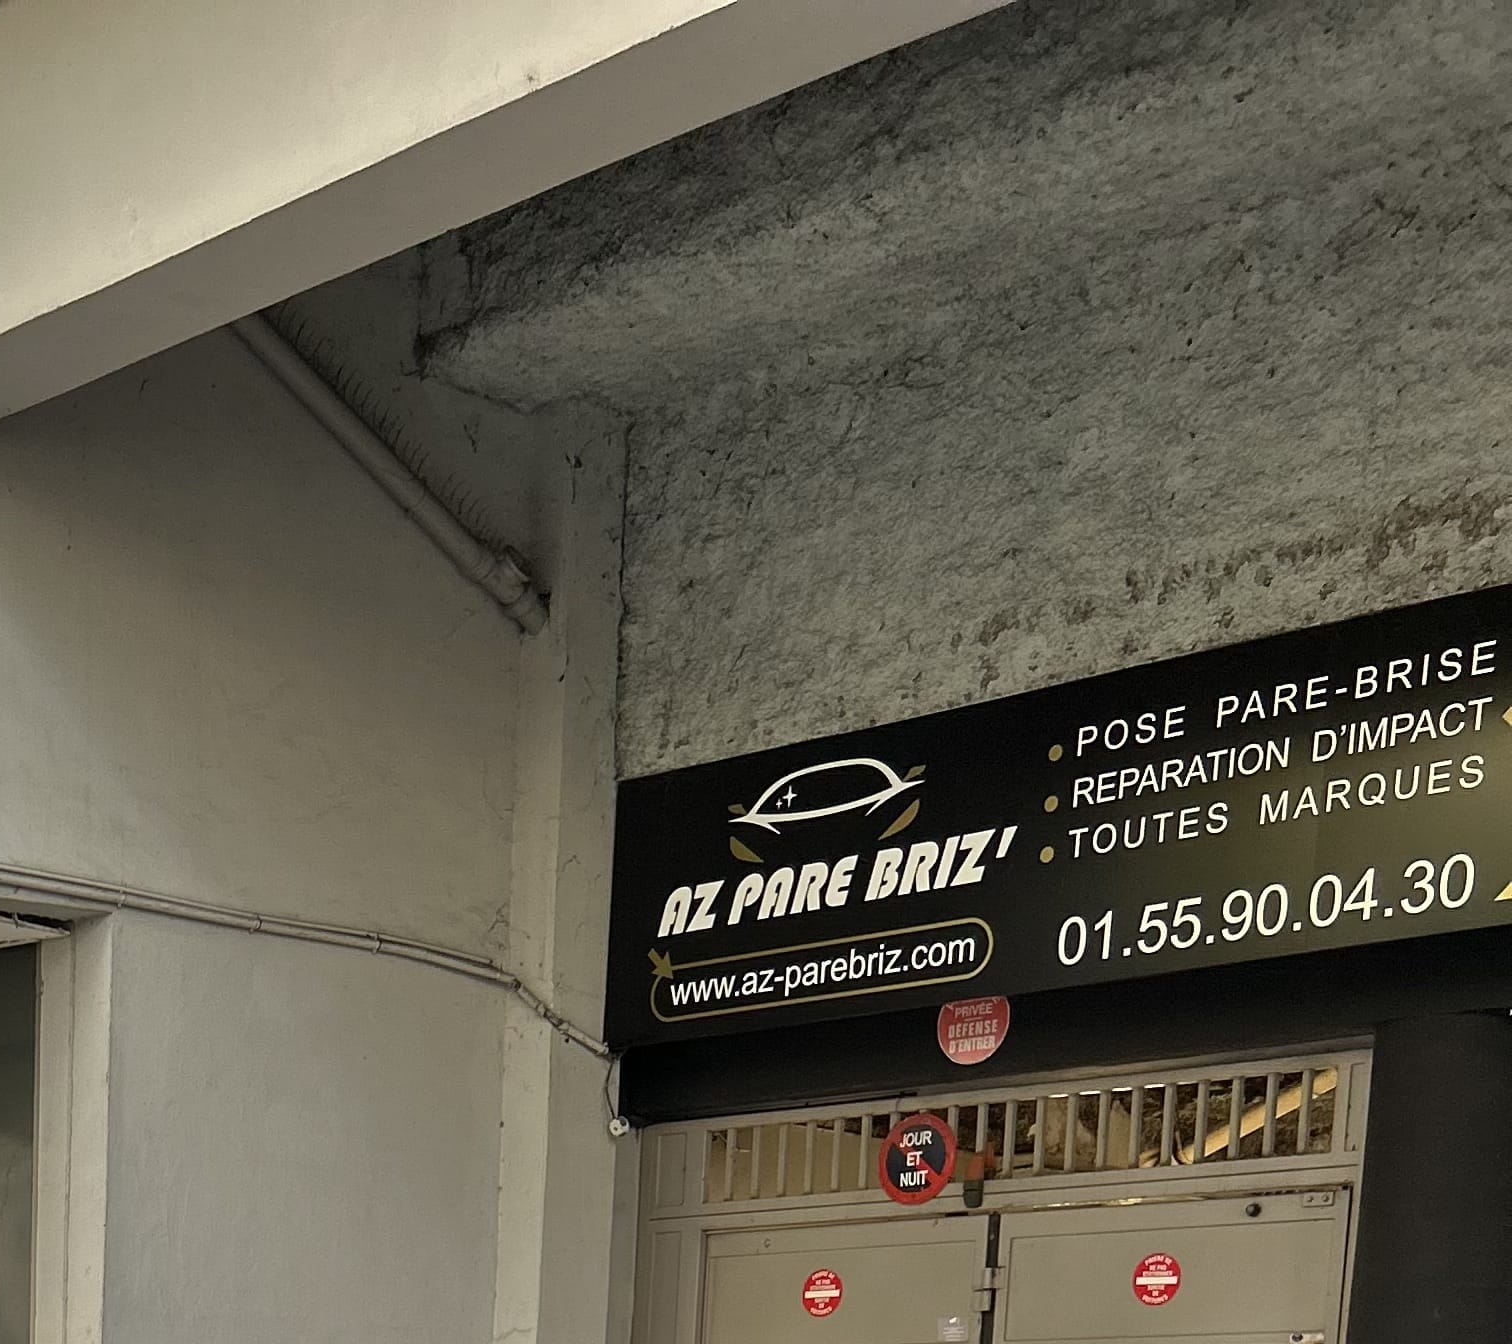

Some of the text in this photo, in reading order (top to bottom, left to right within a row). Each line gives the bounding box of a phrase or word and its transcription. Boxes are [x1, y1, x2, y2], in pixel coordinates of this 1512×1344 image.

[1076, 640, 1498, 757] POSE PARE-BRISE
[1071, 696, 1494, 809] REPARATION D'IMPACT
[1068, 755, 1487, 859] TOUTES MARQUES
[657, 880, 725, 938] AZ
[727, 853, 861, 926] PARE
[1056, 852, 1476, 966] 01.55.90.04.30
[669, 932, 977, 1007] www.az-parebriz.com
[899, 1130, 933, 1148] JOUR
[899, 1169, 929, 1188] NUIT
[906, 1150, 923, 1167] ET
